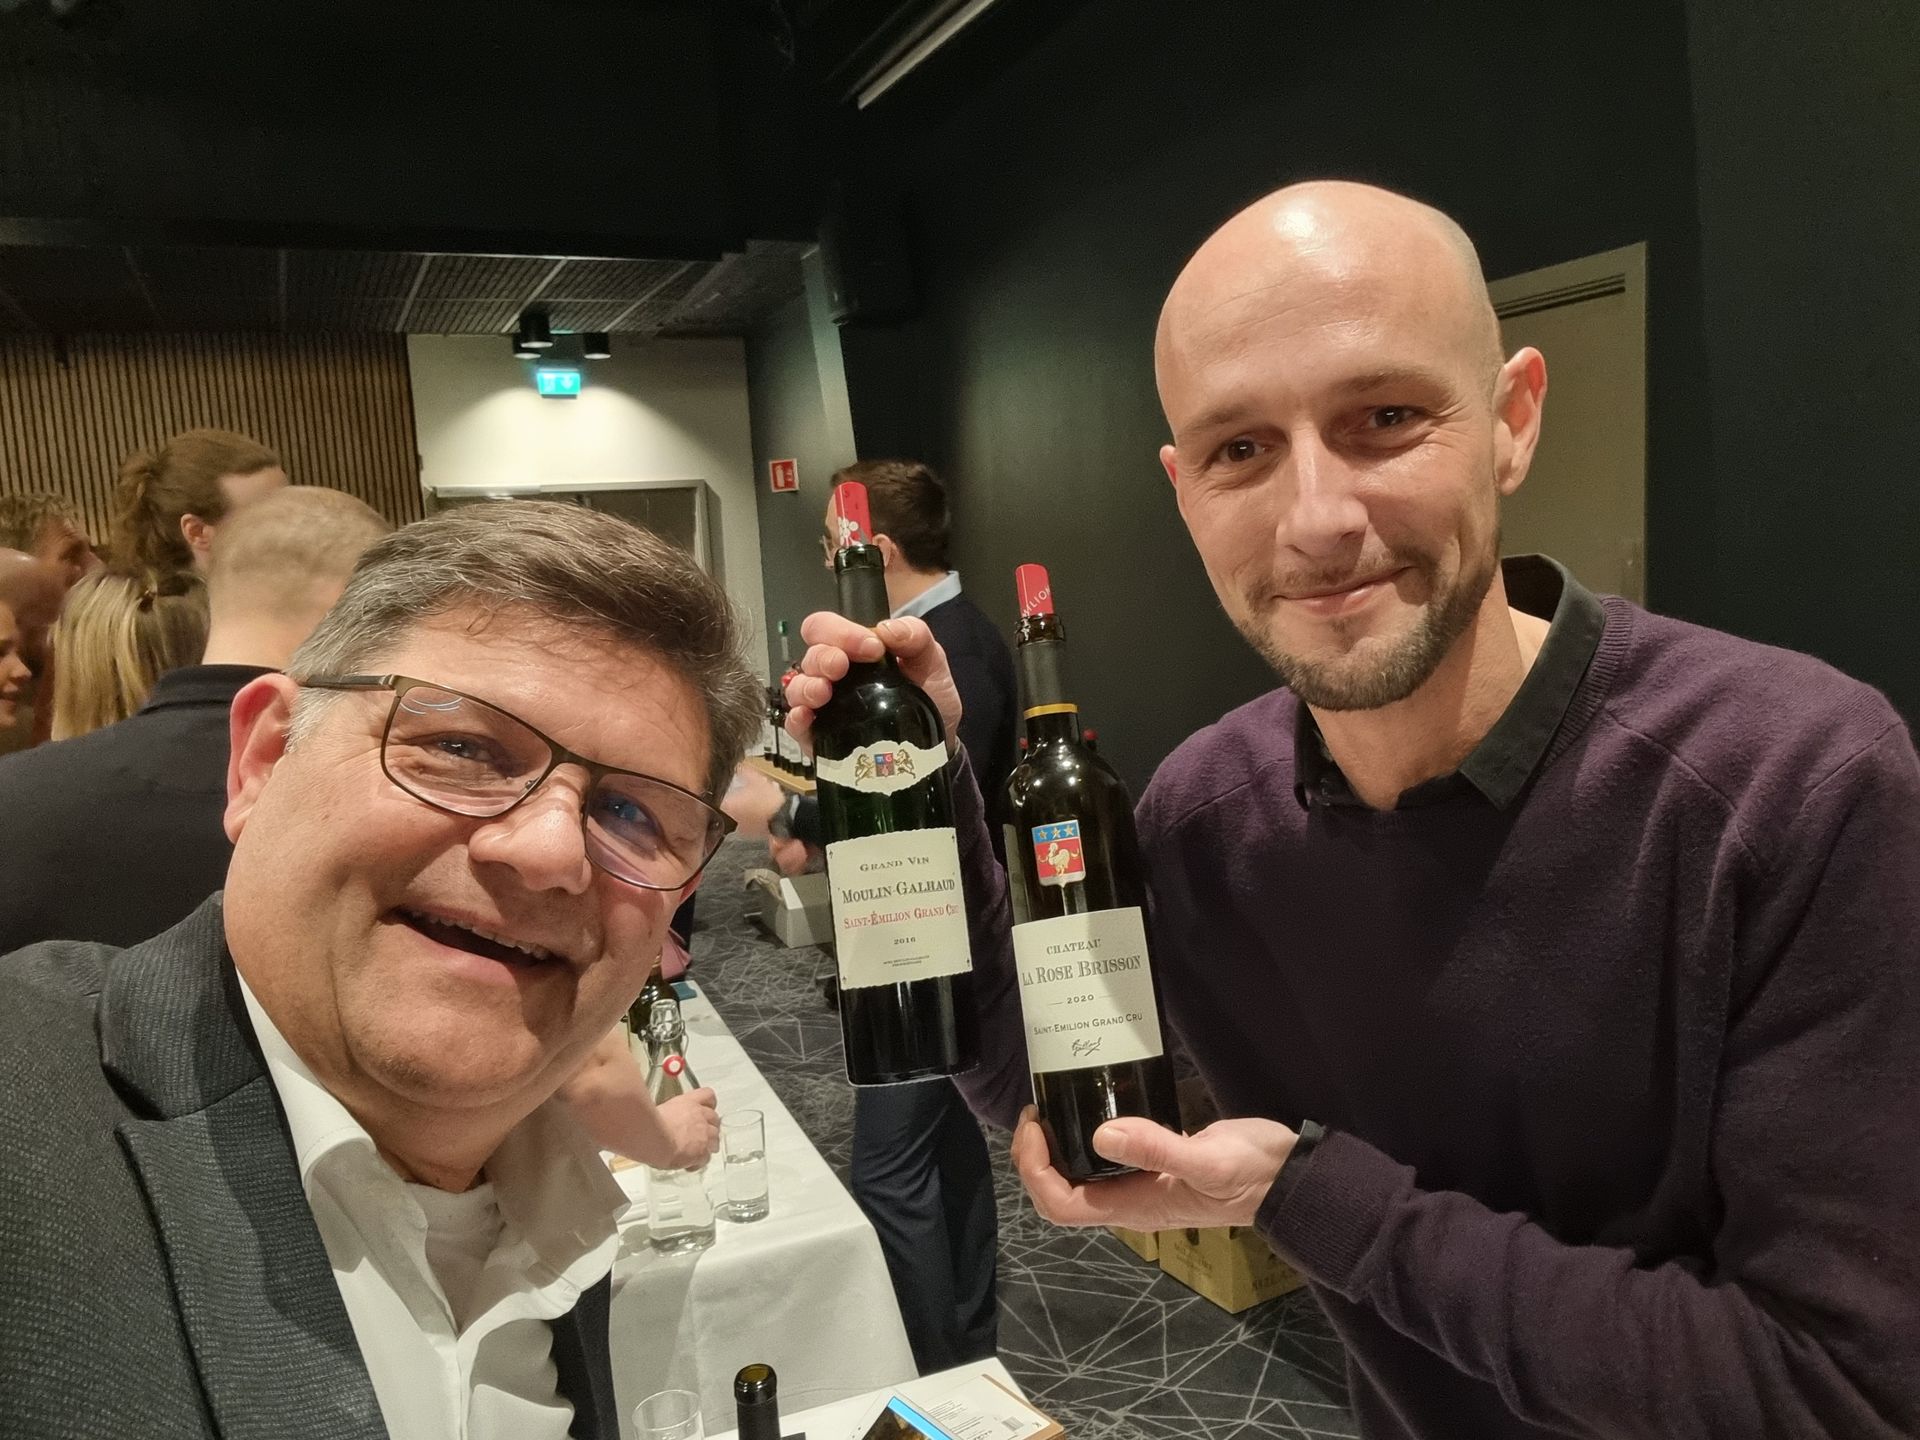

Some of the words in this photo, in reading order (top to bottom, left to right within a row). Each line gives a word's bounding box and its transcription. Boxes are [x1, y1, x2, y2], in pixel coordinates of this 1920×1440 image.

[860, 860, 903, 872] GRAND
[907, 856, 930, 866] VIN
[842, 885, 892, 904] MOULIN
[896, 879, 955, 895] GALHAUD
[914, 907, 945, 920] GRAND
[893, 936, 916, 945] 2016
[1046, 938, 1101, 955] CHATEAU
[1022, 972, 1034, 986] LA
[1035, 964, 1073, 984] ROSE
[1077, 955, 1141, 978] BRISSON
[1067, 994, 1094, 1004] 2020
[1033, 1021, 1089, 1035] SAINT-EMILION
[1092, 1015, 1124, 1028] GRAND
[1125, 1013, 1143, 1022] CRU
